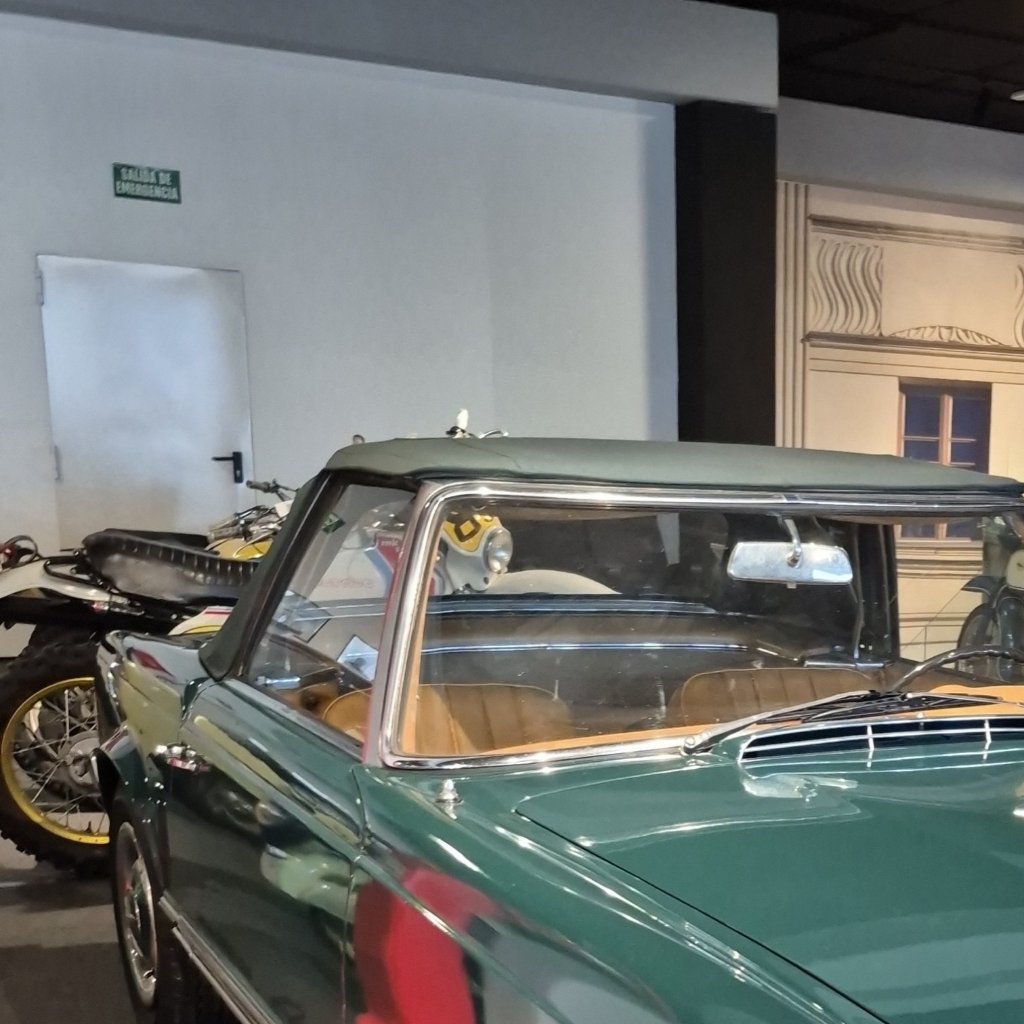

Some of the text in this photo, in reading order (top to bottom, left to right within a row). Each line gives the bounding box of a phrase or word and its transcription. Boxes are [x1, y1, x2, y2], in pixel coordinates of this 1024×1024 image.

[121, 167, 172, 186] SALIDA DE
[116, 180, 179, 200] EMERGENCIA
